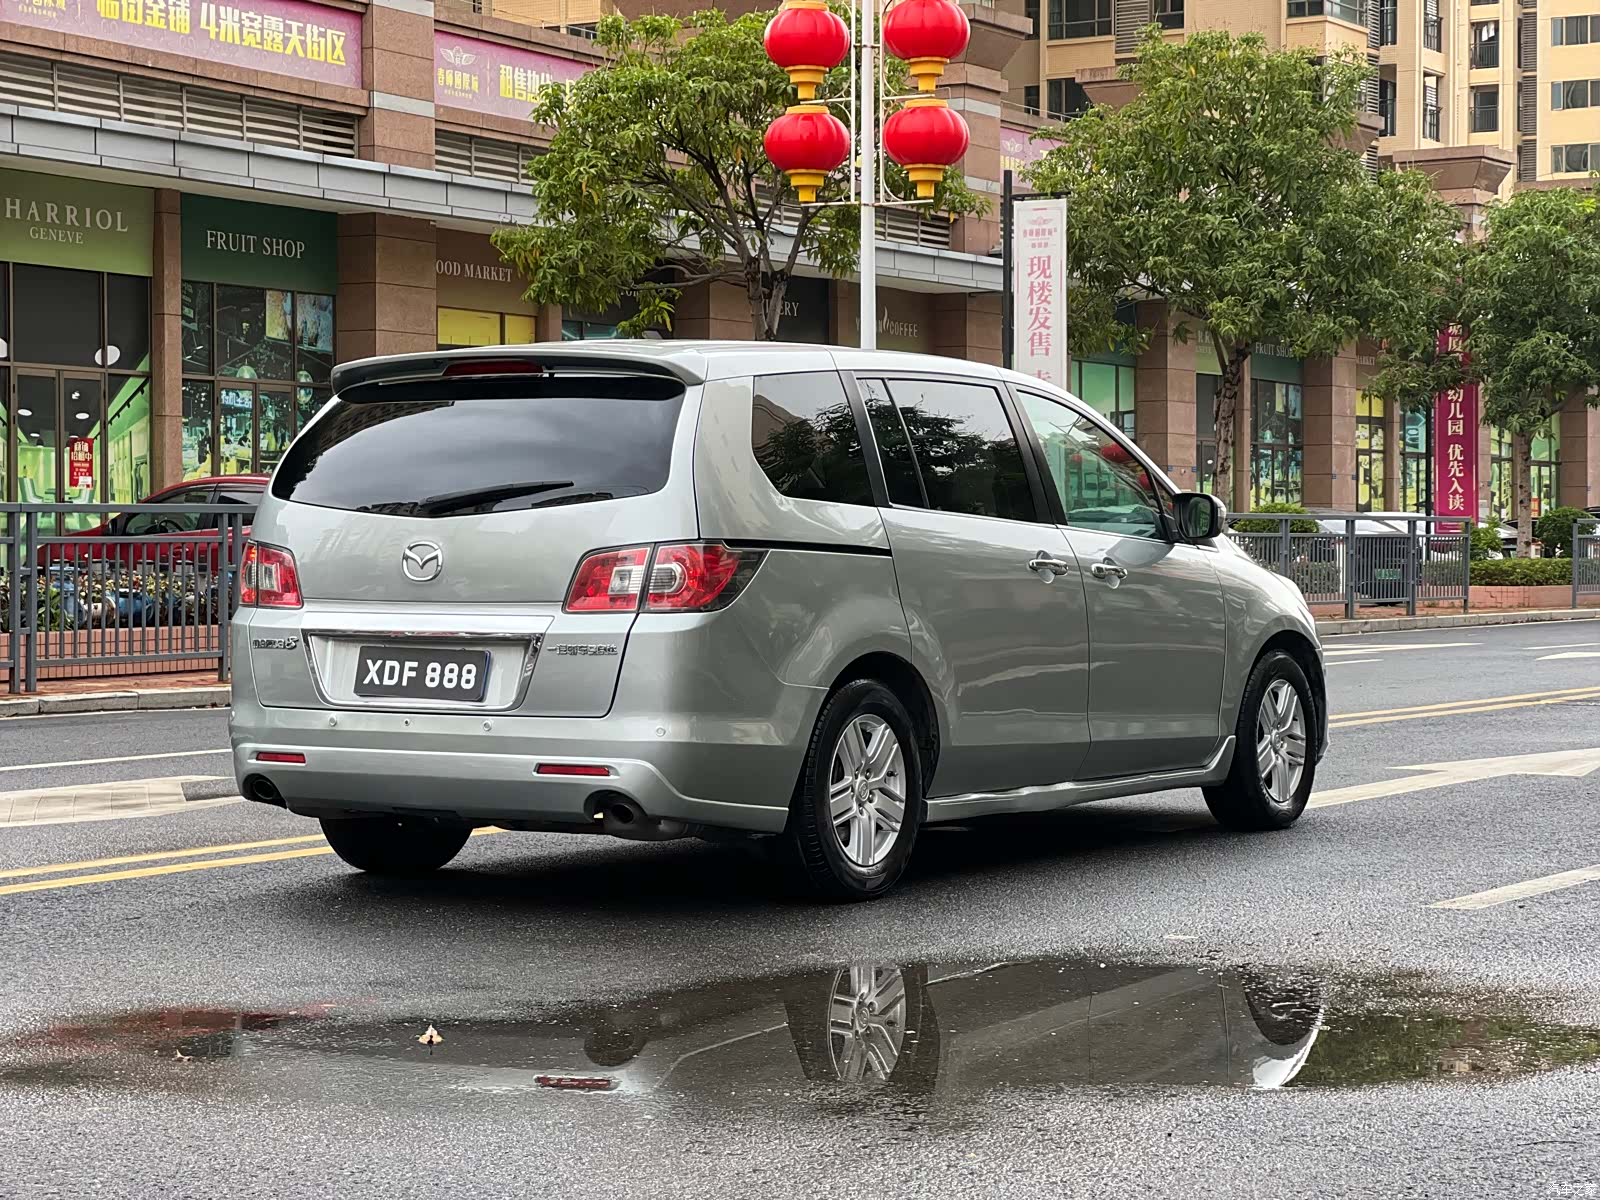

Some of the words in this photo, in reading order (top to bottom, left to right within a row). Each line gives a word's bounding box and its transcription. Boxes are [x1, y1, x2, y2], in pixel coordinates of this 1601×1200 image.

[200, 2, 346, 66] 4米宽露天街区
[5, 197, 129, 232] HARRIOL
[29, 226, 84, 244] GENEVE
[206, 229, 258, 253] FRUIT
[262, 236, 305, 259] SHOP
[435, 259, 461, 276] OOD
[464, 263, 513, 282] MARKET
[1027, 255, 1052, 357] 现楼发售
[889, 320, 918, 338] COFFEE
[1276, 345, 1294, 358] SHO
[1447, 444, 1464, 510] 优先入读
[363, 659, 418, 687] XDF
[425, 662, 477, 690] 888
